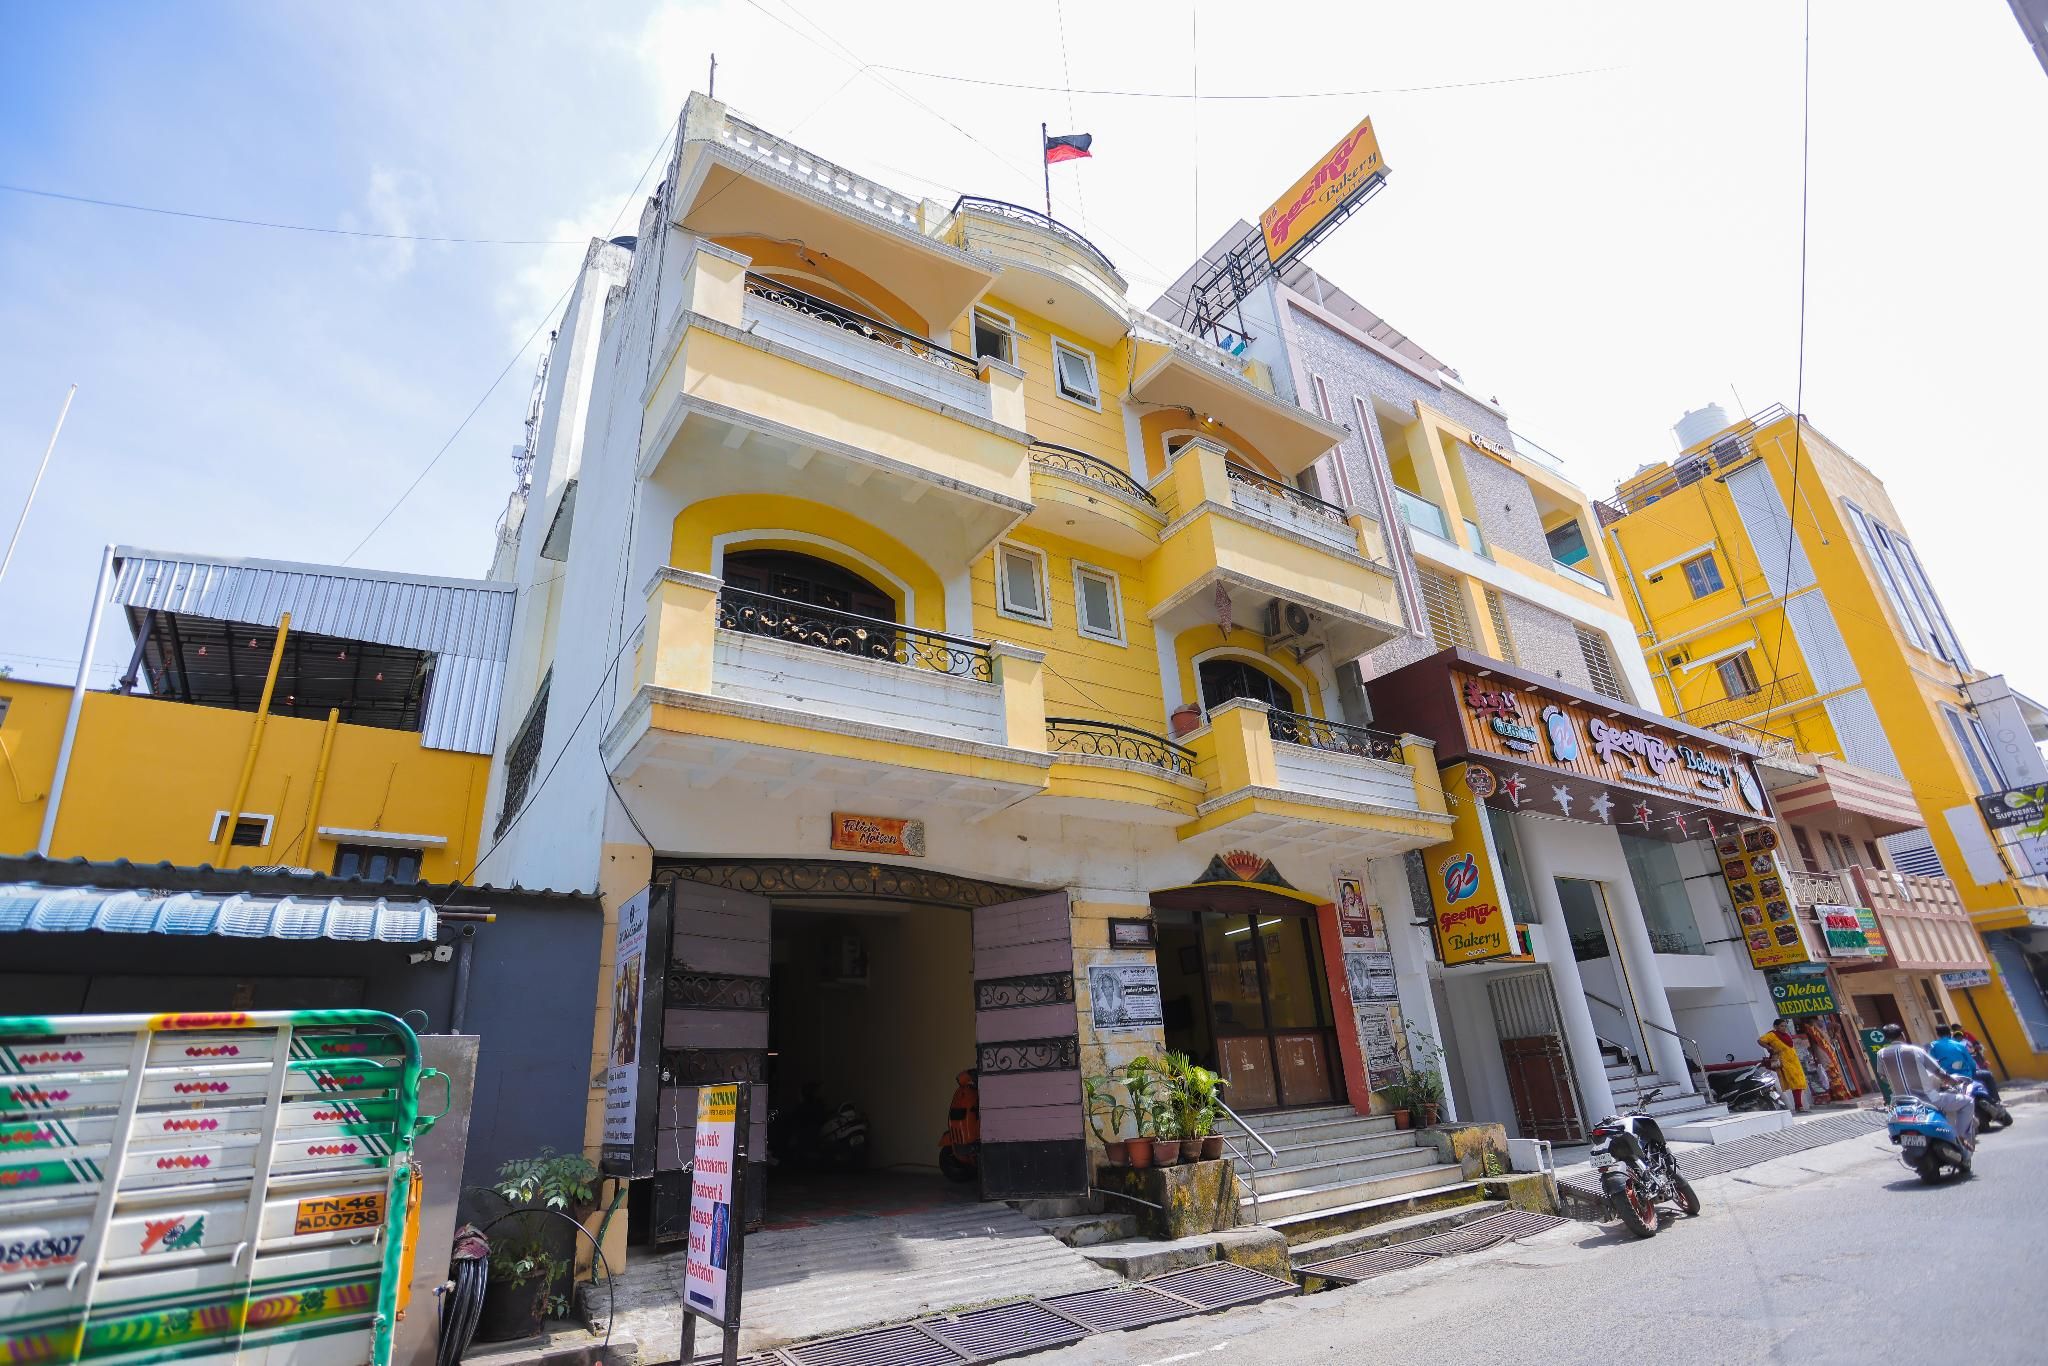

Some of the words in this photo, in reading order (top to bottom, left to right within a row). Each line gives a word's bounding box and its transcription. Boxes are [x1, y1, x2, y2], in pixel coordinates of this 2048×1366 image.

[1318, 152, 1377, 202] Bakery
[1678, 745, 1732, 788] Bakery
[1989, 806, 2000, 814] LE
[1996, 807, 2037, 820] SUPREME
[843, 819, 880, 832] Felicia
[860, 832, 897, 845] Maison
[1448, 932, 1501, 951] Bakery
[1787, 983, 1826, 997] Netra
[1777, 996, 1834, 1015] MEDICALS
[692, 1180, 718, 1200] Treatment
[306, 1195, 377, 1213] TN.46
[691, 1206, 712, 1229] Massage
[689, 1232, 701, 1253] Yoga
[687, 1258, 714, 1284] Meditation
